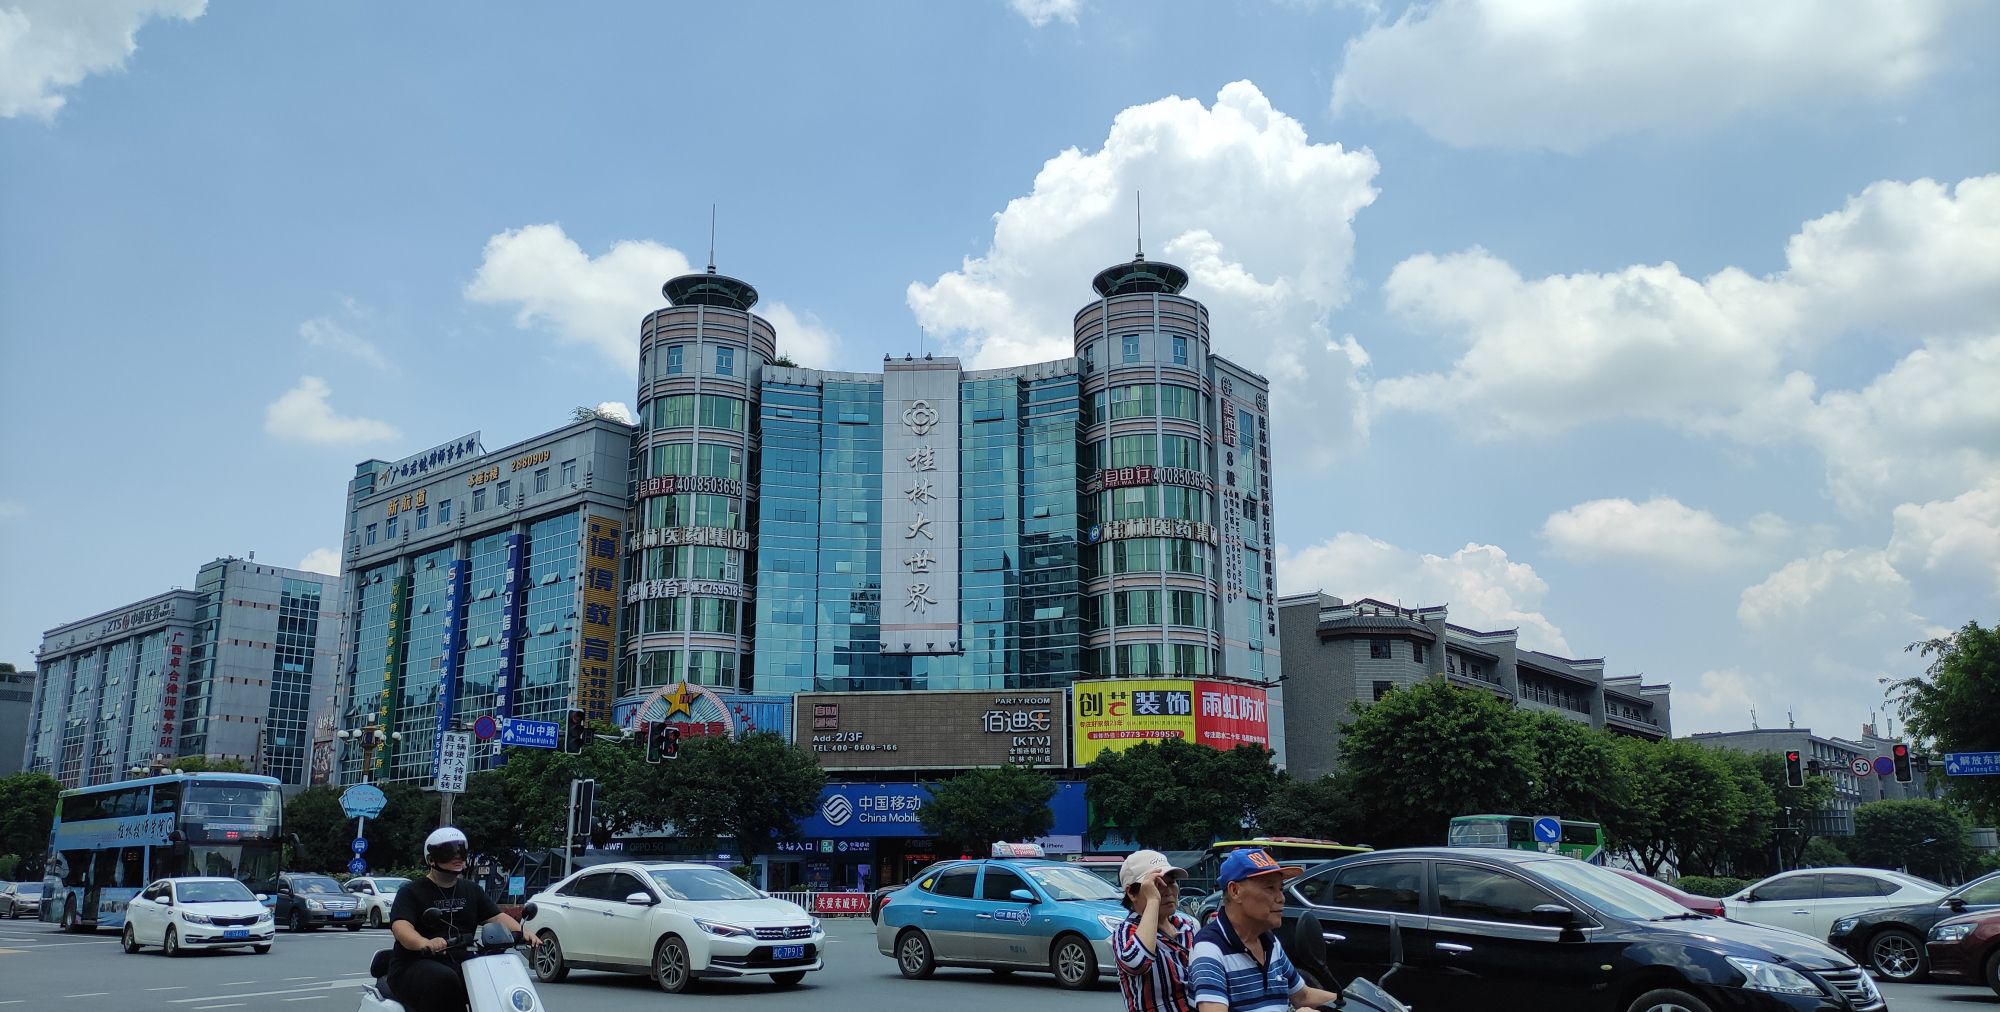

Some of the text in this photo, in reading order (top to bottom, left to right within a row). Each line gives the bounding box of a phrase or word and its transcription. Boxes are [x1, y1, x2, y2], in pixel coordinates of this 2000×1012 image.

[511, 450, 551, 473] 2880909
[640, 475, 742, 496] 自由行 4008503696
[1105, 466, 1151, 483] 自由行
[387, 489, 427, 517] 新航道
[631, 527, 750, 552] 桂林医药集团
[904, 446, 938, 614] 桂林大世界
[1103, 519, 1217, 546] 桂林医药集团
[1223, 488, 1233, 604] 4008503696
[626, 579, 680, 605] 恩斯教育
[708, 583, 743, 597] 7595185
[107, 618, 122, 633] ZTS
[160, 631, 185, 748] 广西卓合律师事务所
[1201, 691, 1266, 723] 雨虹防水
[516, 722, 556, 739] 中山中路
[981, 709, 1051, 733] 佰迪乐
[432, 715, 443, 774] 7595185
[452, 735, 468, 790] 车辆进入待转区
[1009, 755, 1051, 763] 桂林中山店
[1854, 762, 1869, 772] 50
[858, 795, 921, 812] 中国移动
[858, 812, 921, 823] China Mobile
[818, 898, 866, 910] 关爱未成年人
